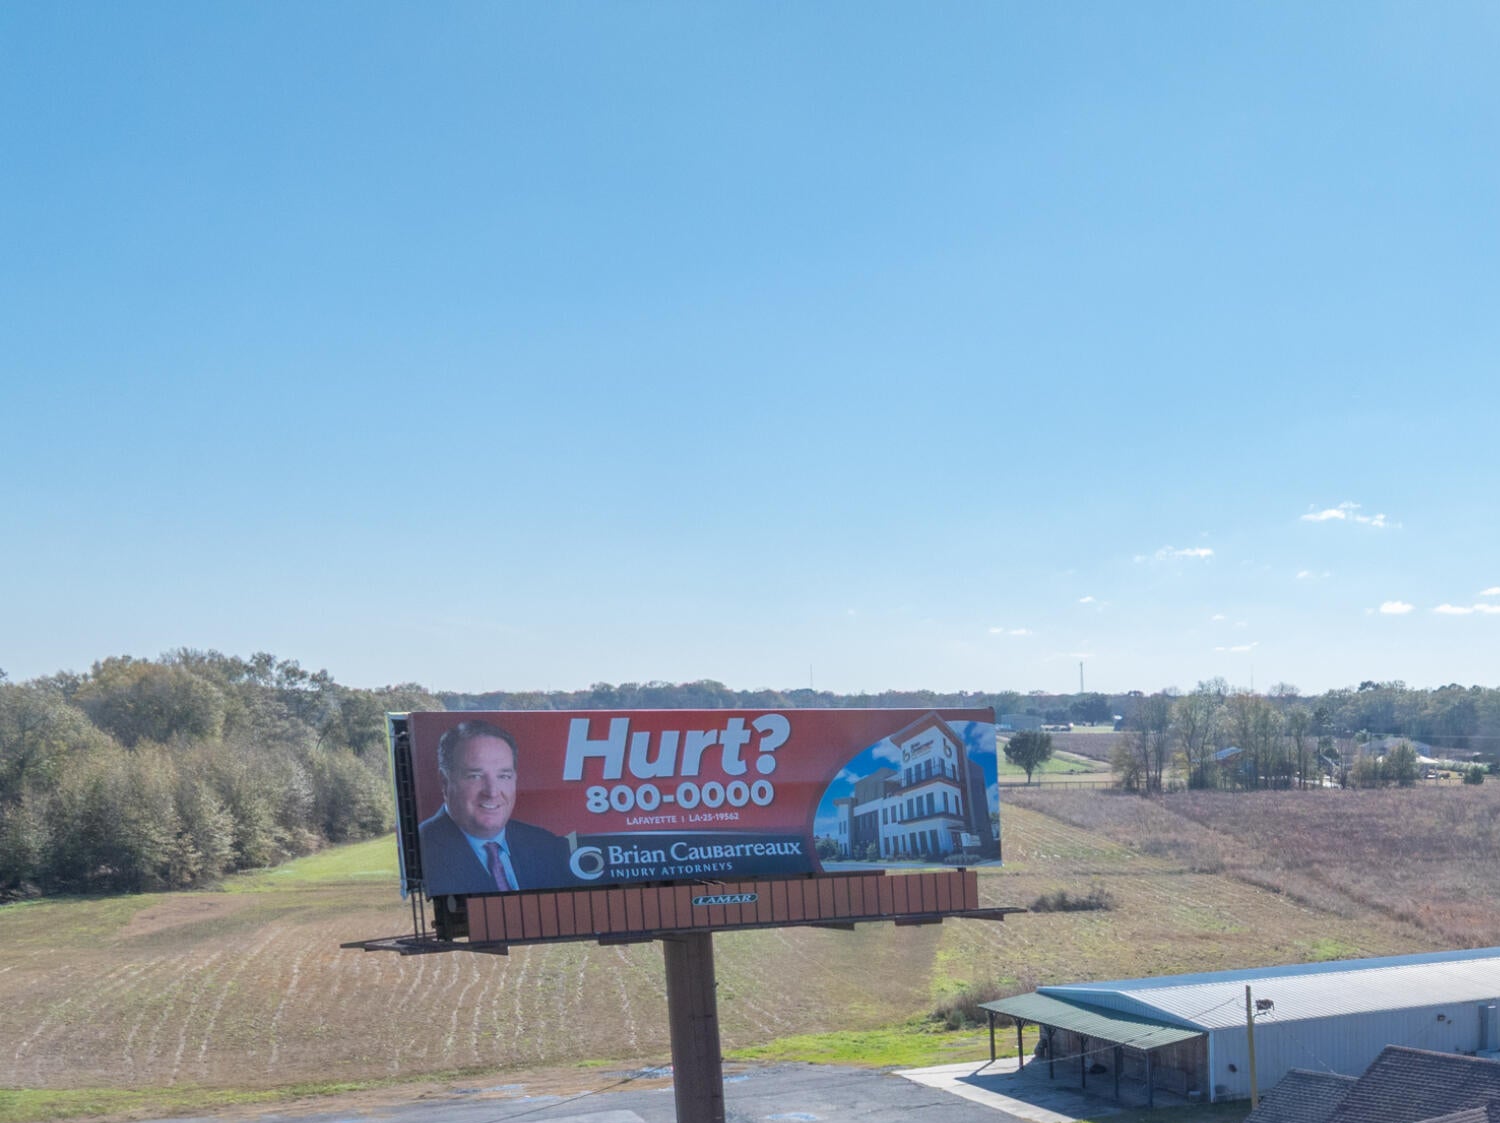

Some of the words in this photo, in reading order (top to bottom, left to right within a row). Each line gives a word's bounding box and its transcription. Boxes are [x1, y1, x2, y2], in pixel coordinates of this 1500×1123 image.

[562, 714, 791, 781] Hurt?
[586, 779, 775, 814] 800-0000
[626, 815, 677, 826] LAFAYETTE
[607, 844, 666, 865] Brian
[610, 867, 656, 879] INJURY
[661, 861, 733, 876] ATTORNEYS
[698, 894, 752, 905] LAMAR
